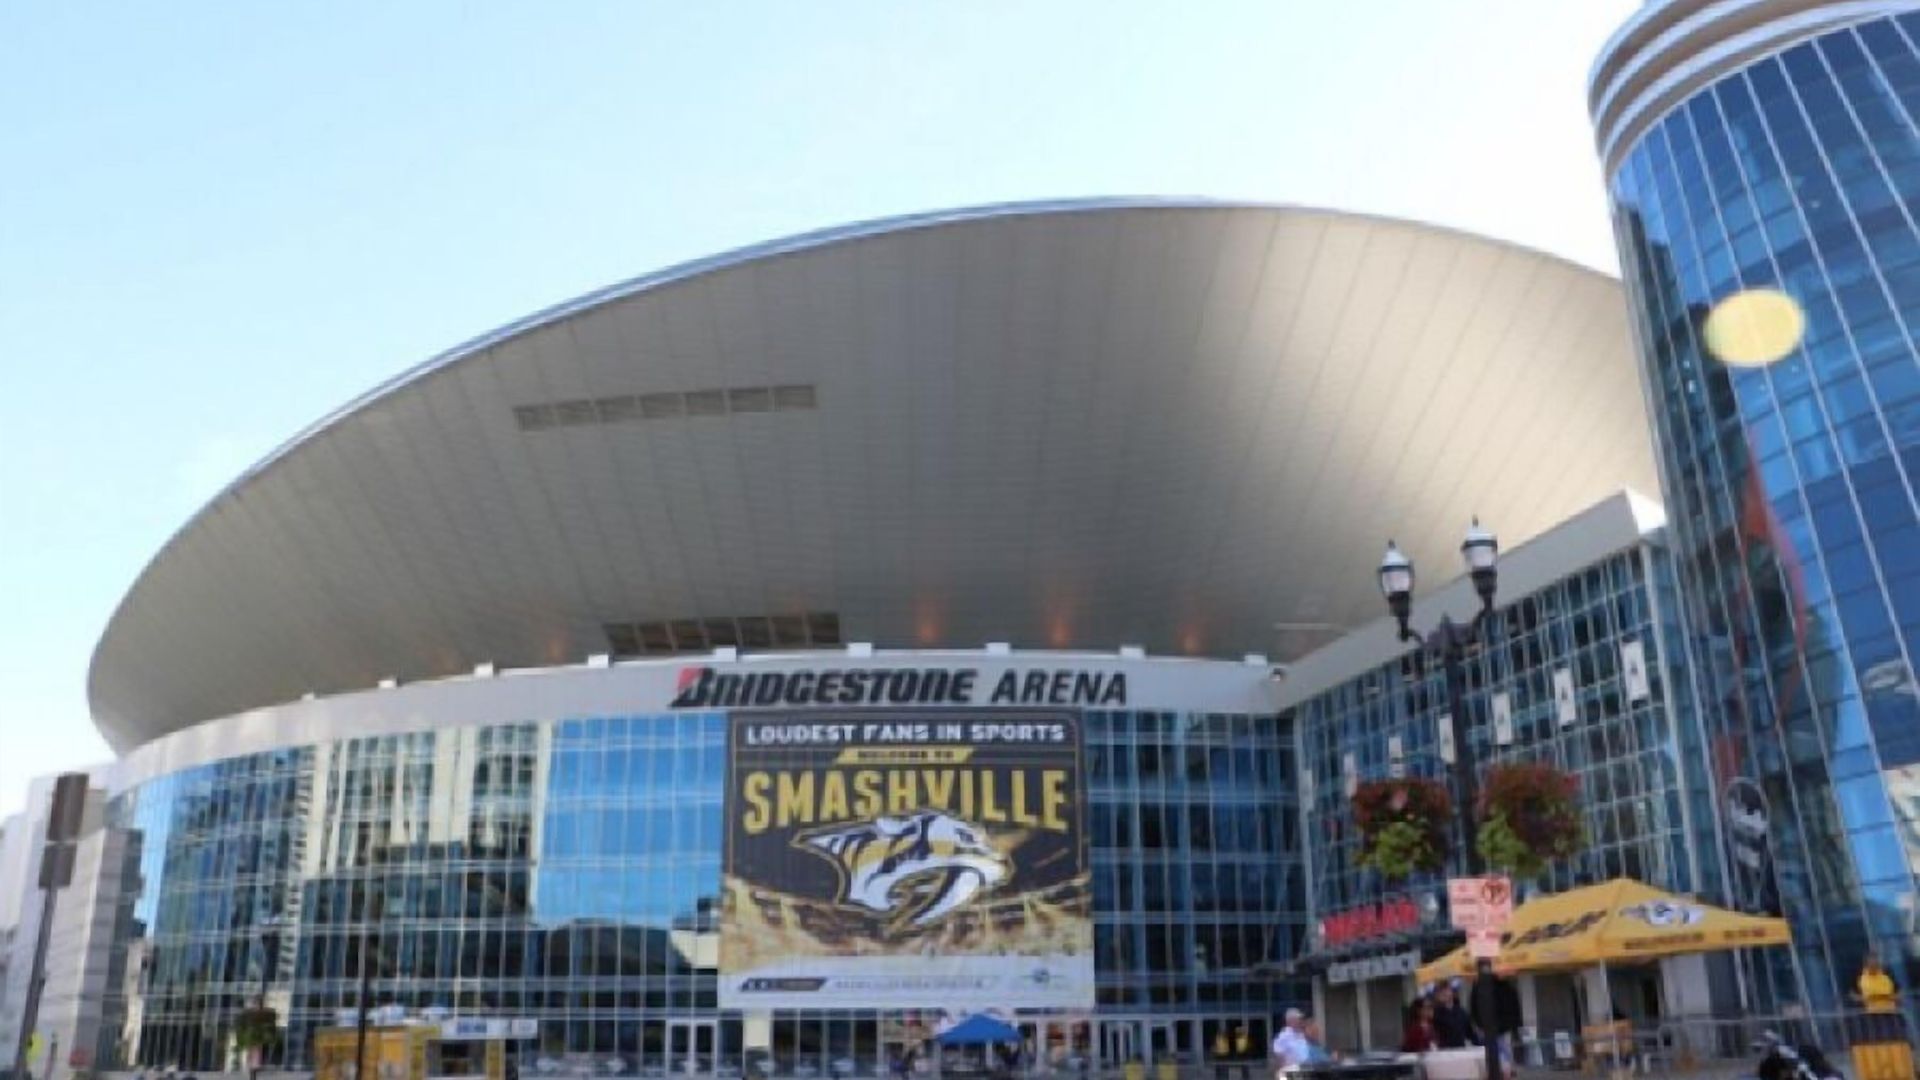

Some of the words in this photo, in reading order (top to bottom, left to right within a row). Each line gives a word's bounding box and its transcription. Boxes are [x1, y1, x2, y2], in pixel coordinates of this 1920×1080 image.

[667, 667, 976, 706] BRIDGESTONE
[991, 668, 1127, 706] ARENA
[747, 724, 857, 745] LOUDEST
[864, 724, 929, 743] FANS
[936, 724, 961, 742] IN
[971, 724, 1065, 743] SPORTS
[743, 770, 1069, 834] SMASHVILLE
